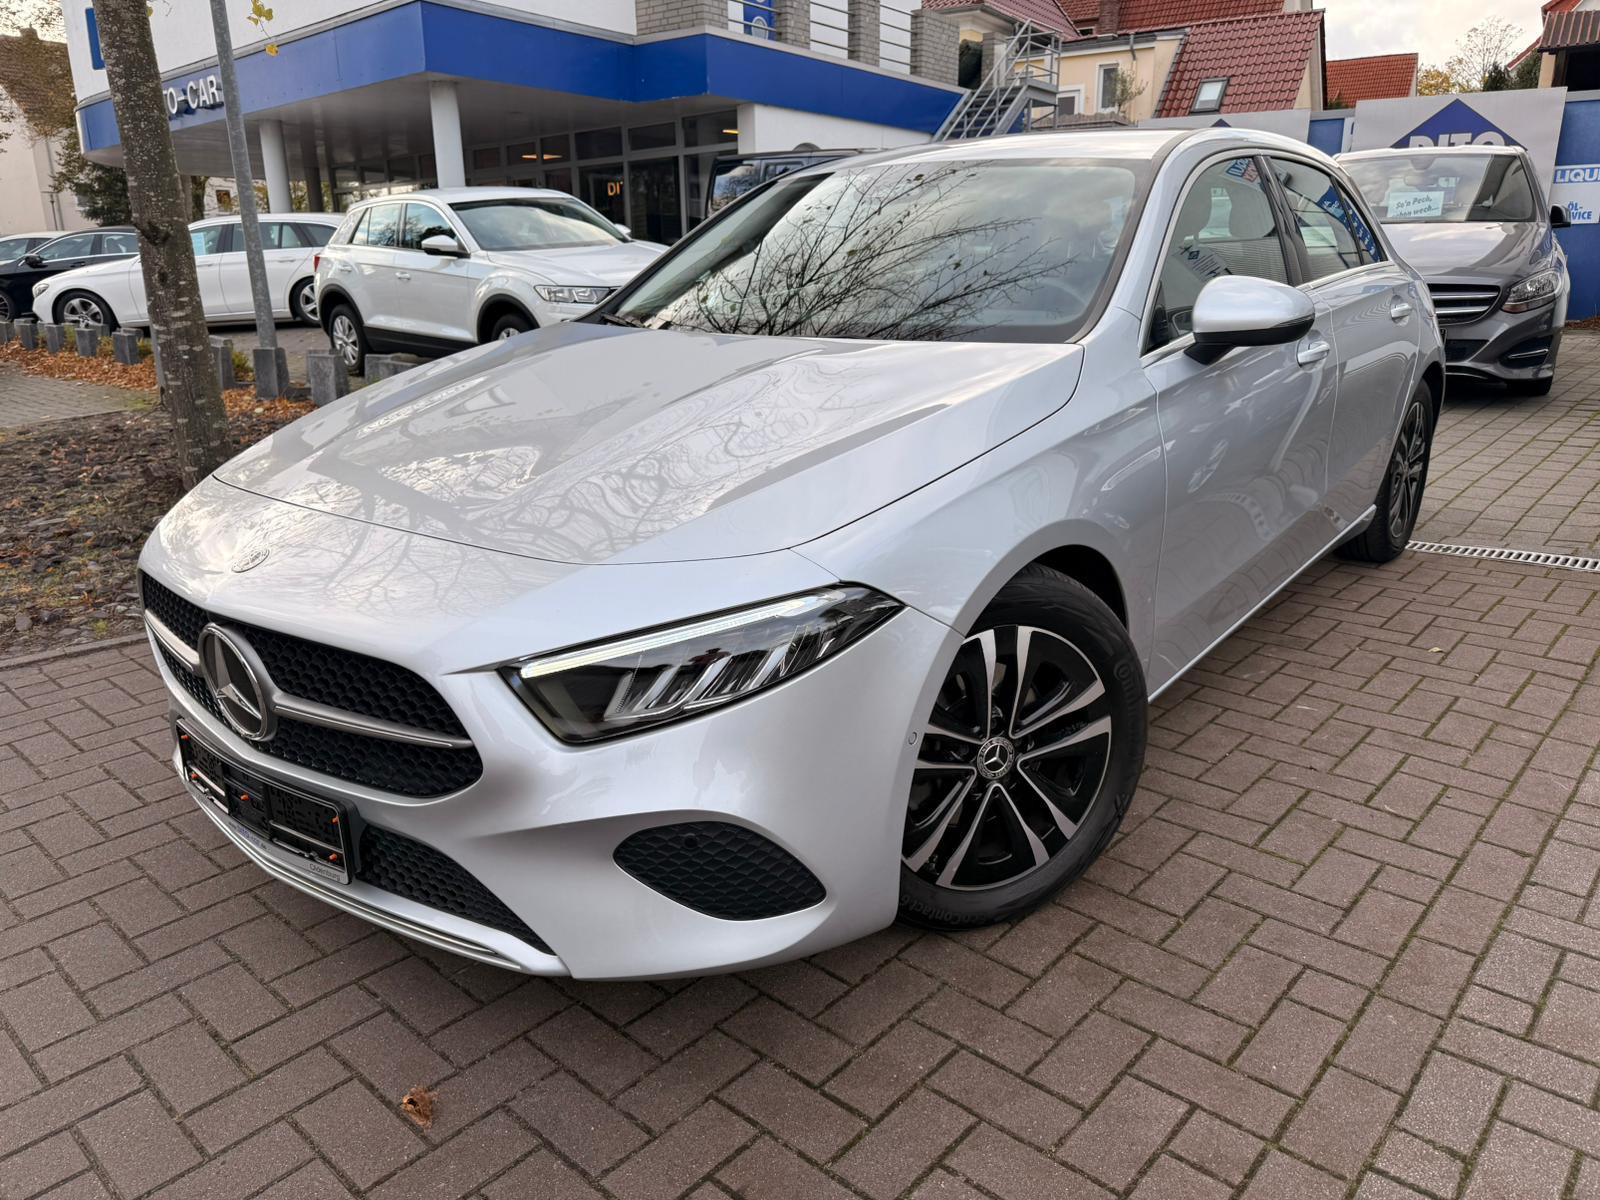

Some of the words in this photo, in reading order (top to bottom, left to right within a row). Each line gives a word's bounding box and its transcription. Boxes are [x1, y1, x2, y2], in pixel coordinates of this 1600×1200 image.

[163, 75, 220, 114] O-CAR
[607, 181, 624, 196] DI
[1568, 210, 1592, 220] VICE
